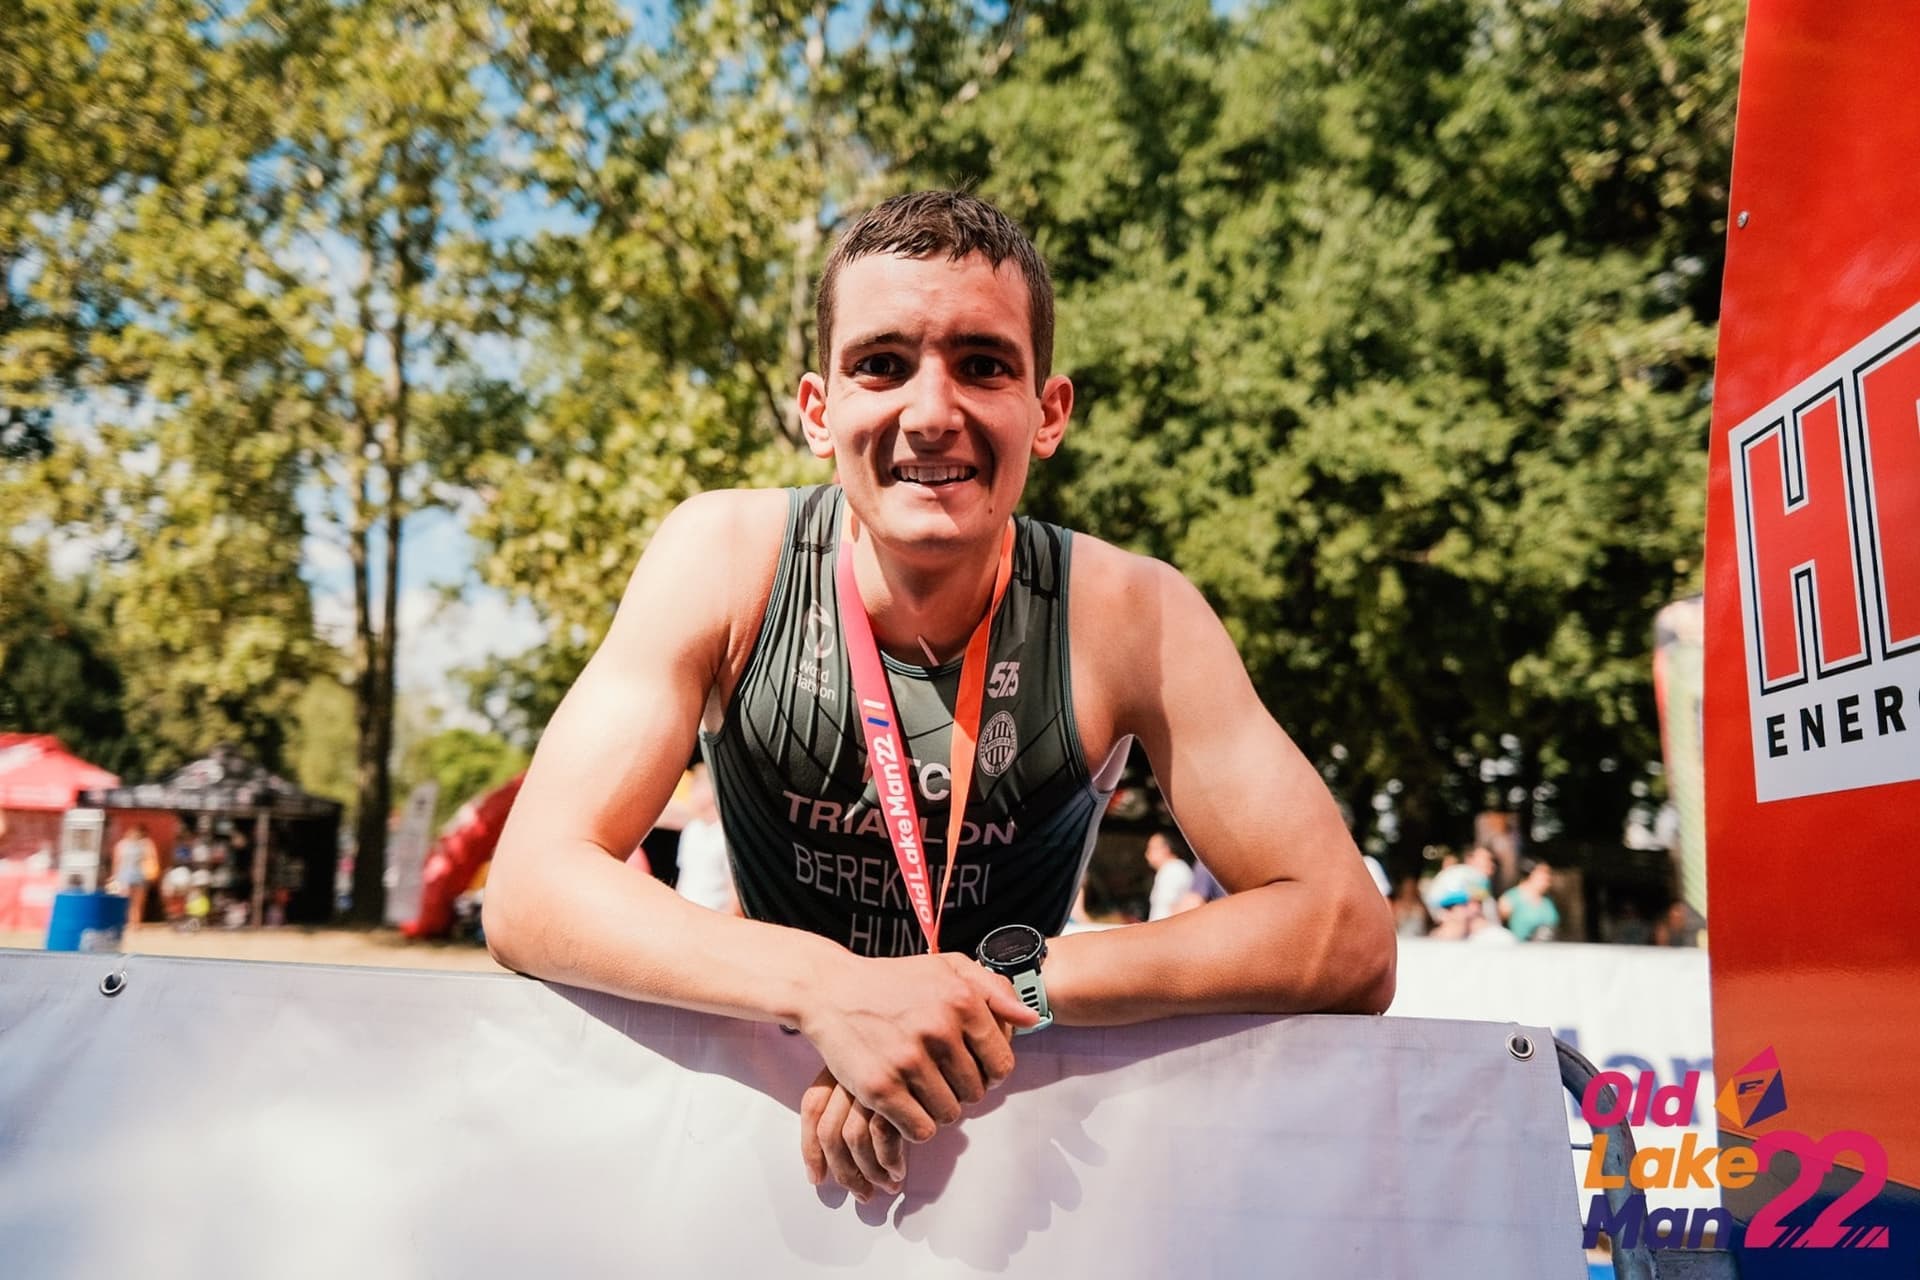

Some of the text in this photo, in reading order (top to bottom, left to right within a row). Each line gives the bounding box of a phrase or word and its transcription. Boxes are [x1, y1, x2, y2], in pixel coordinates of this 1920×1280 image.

[791, 667, 835, 701] Tiaton
[1767, 685, 1920, 758] ENER
[783, 790, 1017, 846] TRIALON
